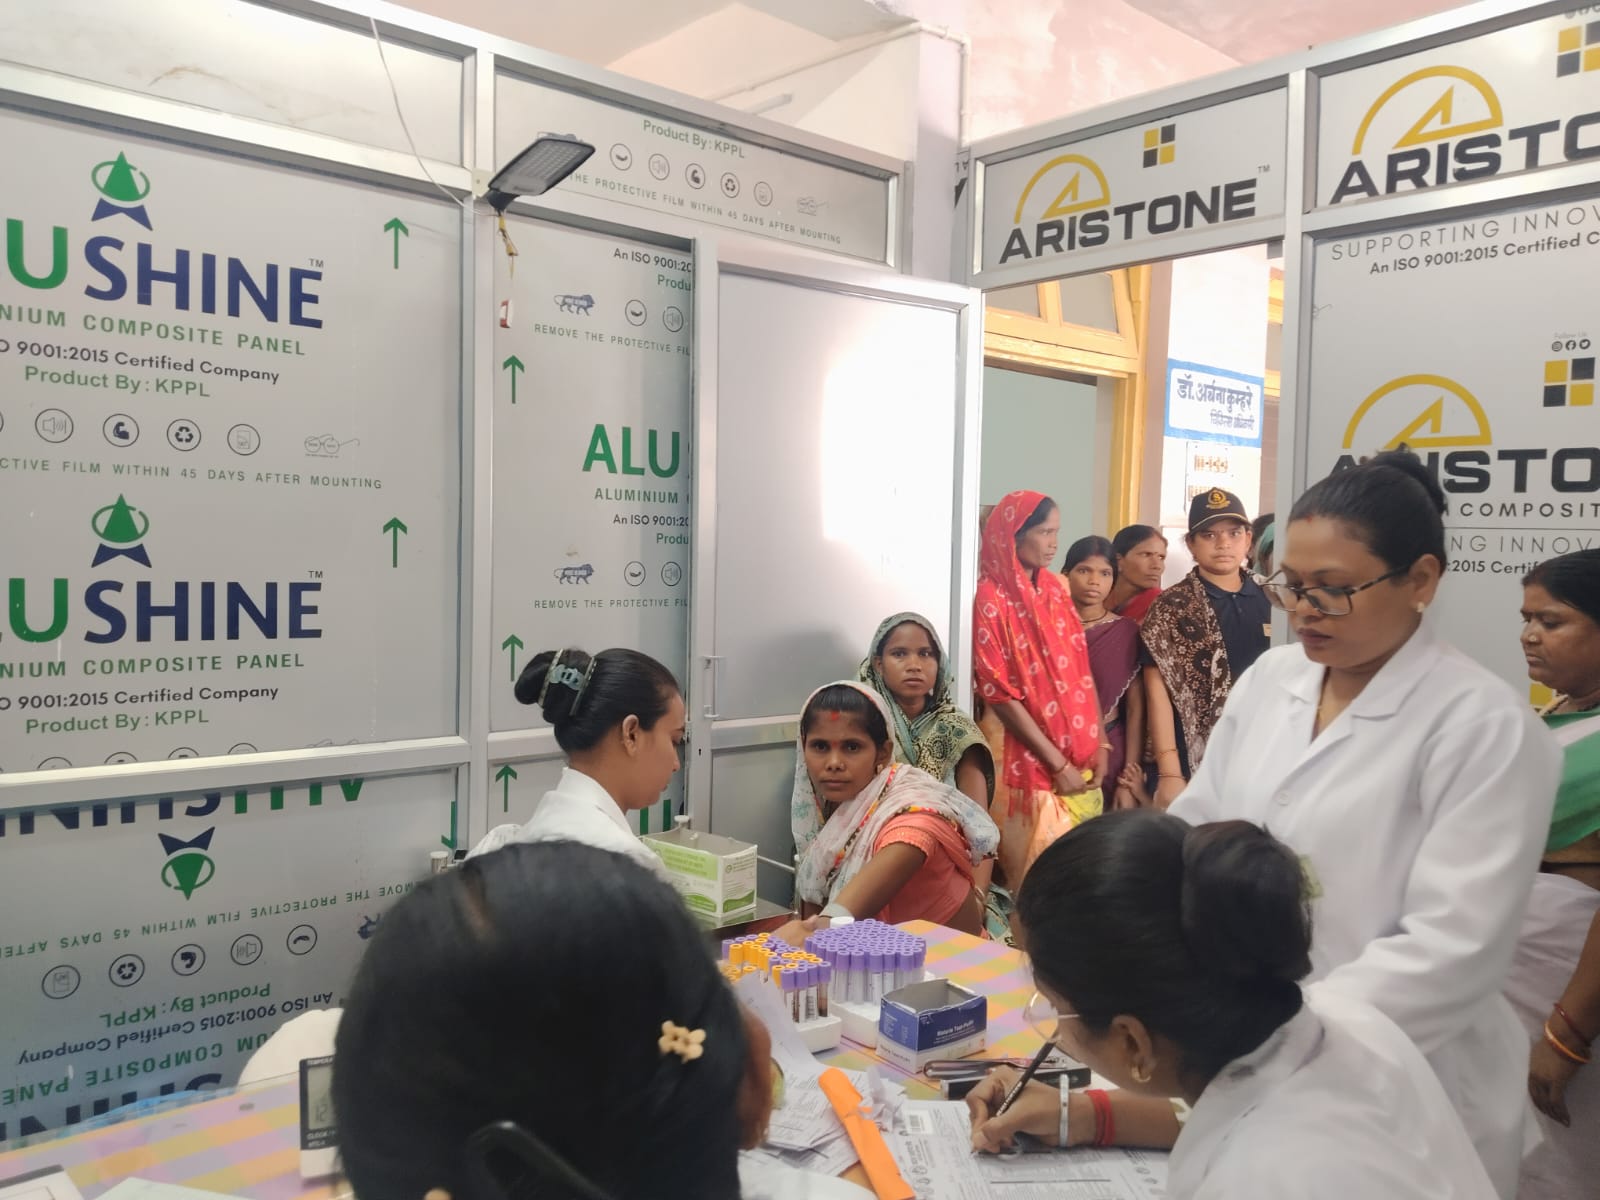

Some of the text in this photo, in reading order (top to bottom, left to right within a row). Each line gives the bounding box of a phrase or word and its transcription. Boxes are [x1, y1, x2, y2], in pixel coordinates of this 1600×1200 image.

[643, 120, 690, 144] Product
[714, 141, 745, 159] KPPL
[569, 173, 841, 244] THE PROTECTIVE FILM WITHIN 45 DAYS AFTER MOUNTING
[999, 178, 1257, 264] ARISTONE
[1331, 220, 1500, 261] SUPPORTING
[308, 258, 324, 268] TM
[614, 248, 629, 260] An
[631, 251, 651, 263] ISO
[1370, 262, 1389, 274] An
[1393, 257, 1419, 271] ISO
[1424, 245, 1498, 267] 9001:2015
[1503, 232, 1581, 256] Certified
[83, 314, 223, 346] COMPOSITE
[237, 333, 306, 356] PANEL
[535, 323, 579, 338] REMOVE
[585, 331, 605, 342] THE
[610, 336, 671, 353] PROTECTIVE
[17, 340, 109, 364] 9001:2015
[115, 351, 194, 373] Certified
[199, 361, 279, 385] Company
[25, 365, 108, 389] Product
[155, 378, 210, 397] KPPL
[582, 423, 680, 478] ALU
[63, 461, 100, 473] FILM
[113, 463, 170, 477] WITHIN
[181, 468, 197, 478] 45
[208, 469, 245, 481] DAYS
[256, 472, 300, 484] AFTER
[310, 475, 382, 489] MOUNTING
[594, 487, 679, 504] ALUMINIUM
[613, 514, 628, 525] An
[630, 514, 650, 525] ISO
[1500, 536, 1593, 554] INNOV
[0, 570, 323, 644] USHINE TM
[534, 599, 577, 609] REMOVE
[584, 599, 603, 608] THE
[610, 598, 669, 608] PROTECTIVE
[83, 656, 223, 675] COMPOSITE
[237, 653, 305, 669] PANEL
[18, 692, 108, 709] 9001:2015
[114, 688, 193, 704] Certified
[199, 686, 278, 702] Company
[26, 715, 108, 734] Product
[155, 709, 209, 726] KPPL
[251, 895, 337, 918] PROTECTIVE
[346, 889, 370, 902] THE
[142, 918, 196, 936] WITHIN
[207, 911, 240, 925] FILM
[60, 932, 102, 948] DAYS
[113, 928, 130, 940] 45
[0, 940, 47, 959] AFTE
[200, 983, 271, 1008] Product
[18, 991, 333, 1065] An ISO 9001:2015 Certified Company
[100, 1005, 157, 1028] KPPL
[86, 1043, 223, 1087] COMPOSITE
